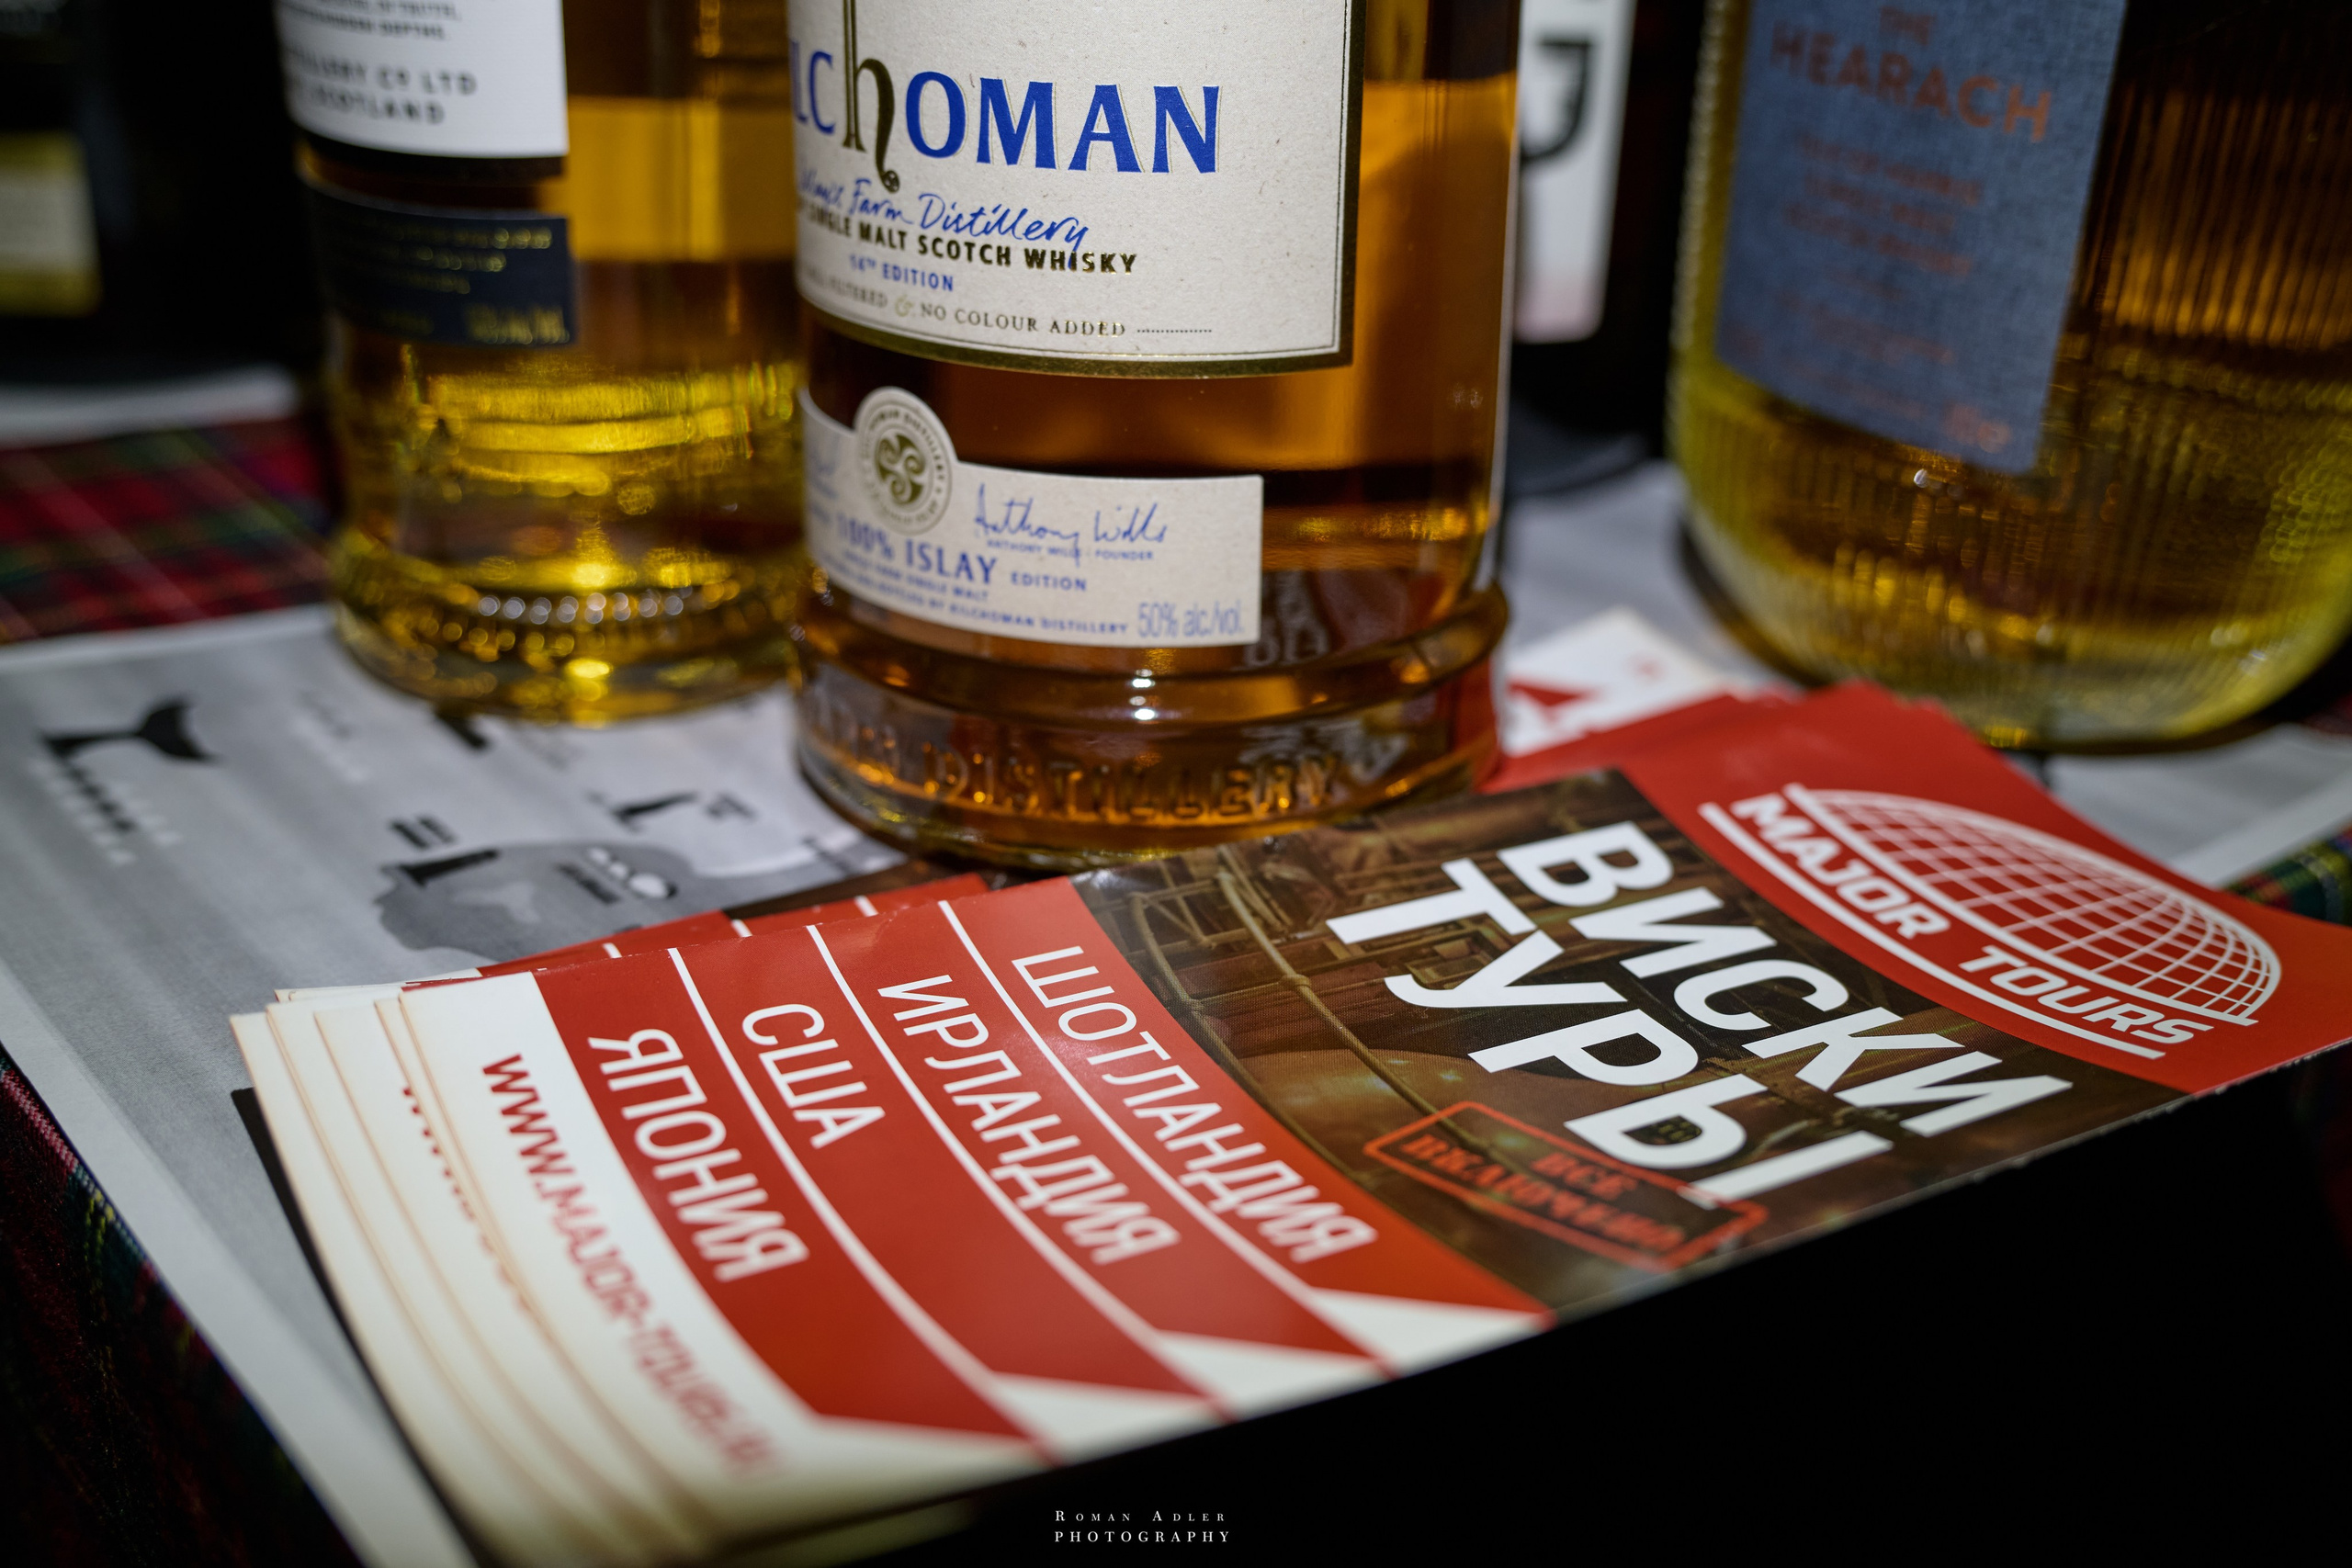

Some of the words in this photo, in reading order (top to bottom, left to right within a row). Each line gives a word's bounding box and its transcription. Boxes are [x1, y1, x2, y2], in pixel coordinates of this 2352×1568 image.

[420, 70, 477, 96] LTD
[1770, 20, 2052, 143] HEARACH
[858, 220, 907, 251] MALT
[917, 234, 1012, 267] SCOTCH
[1023, 247, 1137, 275] WHISKY
[918, 192, 1090, 268] Distillery
[881, 262, 954, 292] EDITION
[920, 302, 947, 321] NO
[954, 308, 1039, 333] COLOUR
[1048, 320, 1126, 337] ADDED
[905, 537, 998, 585] ISLAY
[1011, 571, 1088, 592] EDITION
[986, 538, 1043, 554] ANTHONY
[1094, 549, 1155, 561] FOUNDER
[1040, 616, 1128, 636] DISTILLERY
[1138, 601, 1179, 638] 50%
[1730, 793, 1951, 939] MAJOR
[1959, 945, 2214, 1044] TOURS
[1495, 819, 2074, 1137] ВИСКИ
[1326, 857, 1894, 1210] ТУРЫ
[741, 1003, 887, 1149] США
[1012, 945, 1378, 1264] ШОТЛАНДИЯ
[877, 974, 1182, 1266] ИРЛАНДИЯ
[587, 1027, 810, 1283] ЯПОНИЯ
[1532, 1152, 1638, 1201] ВСЕ
